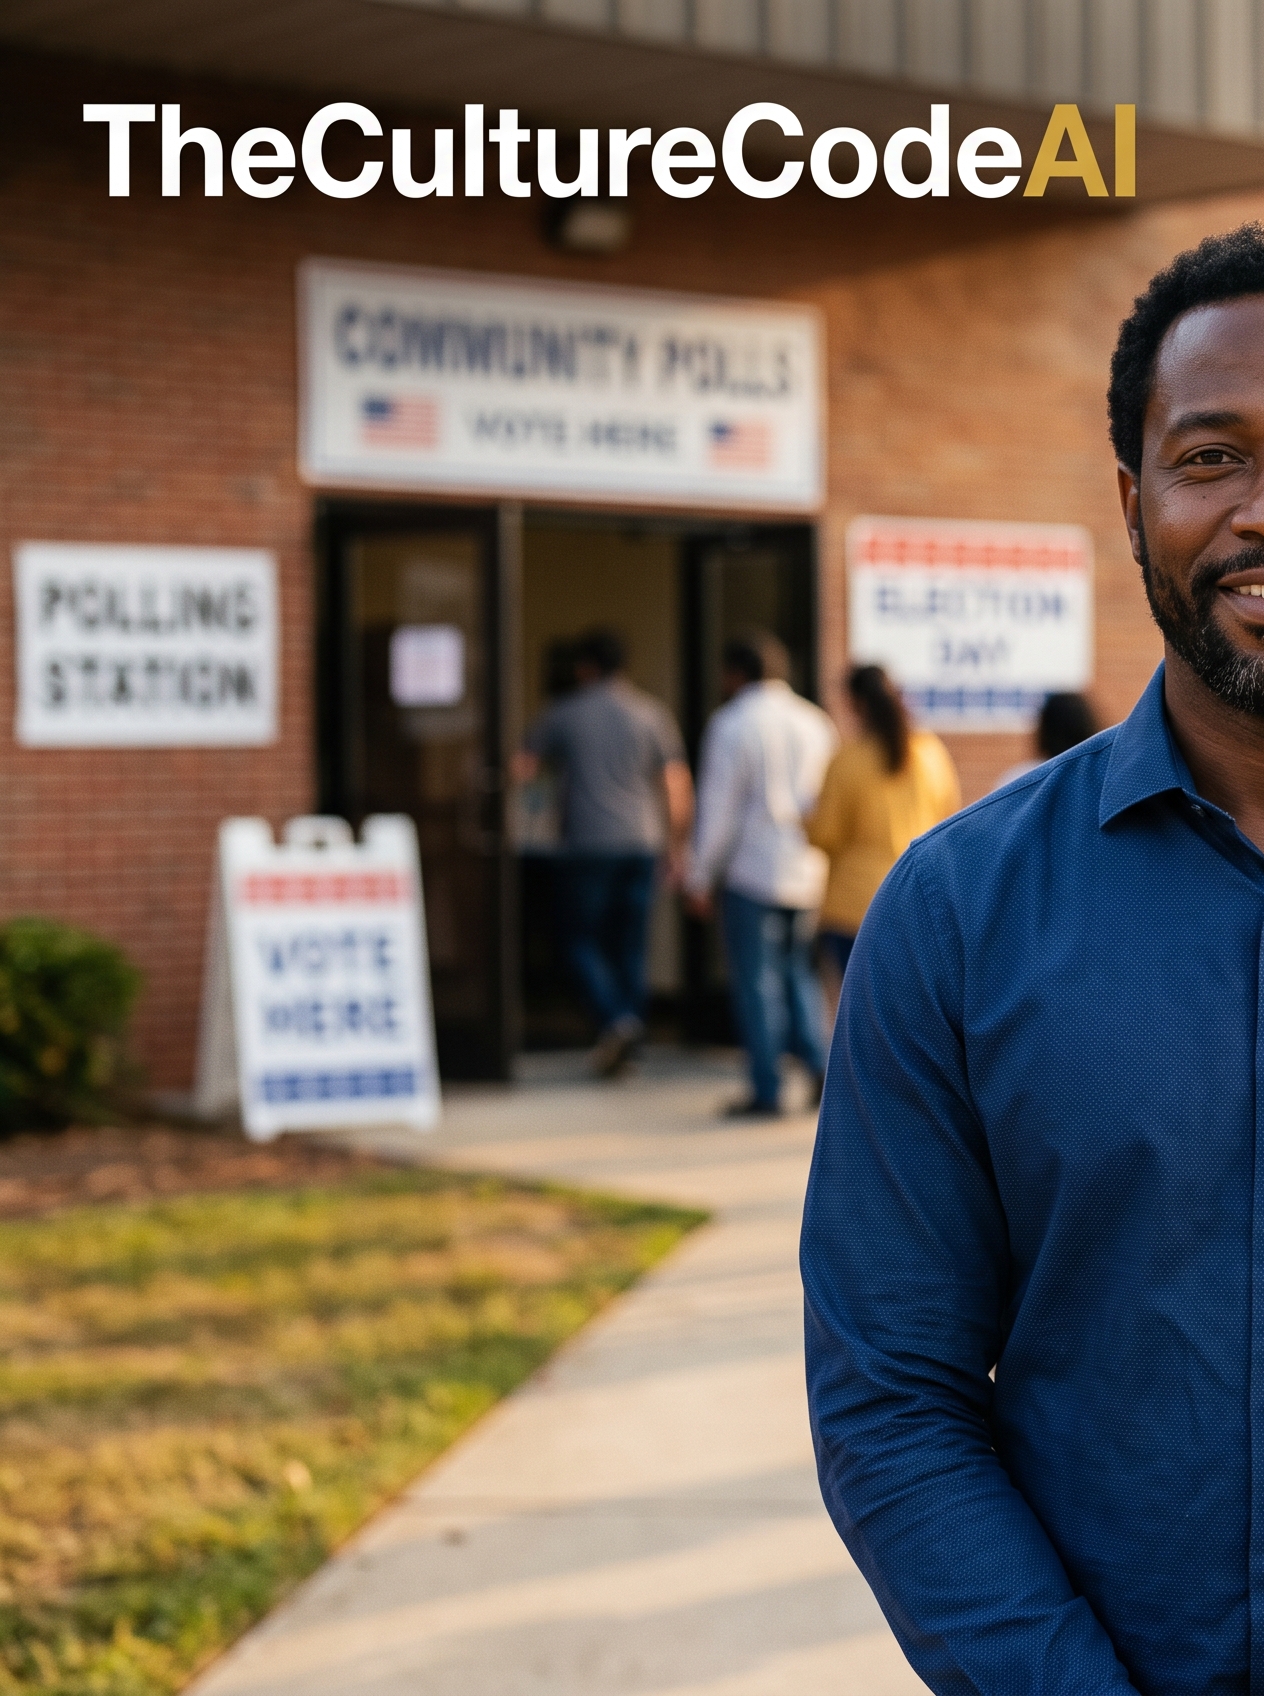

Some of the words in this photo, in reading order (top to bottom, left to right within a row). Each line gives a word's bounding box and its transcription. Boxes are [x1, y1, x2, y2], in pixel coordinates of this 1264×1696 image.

[333, 303, 640, 388] COMMUNITY
[658, 331, 793, 399] POLLS
[41, 577, 256, 635] POLLING
[875, 582, 1067, 624] ELECTION
[43, 655, 256, 712] STATION
[256, 931, 391, 977] VOTE
[264, 997, 400, 1042] HERE
